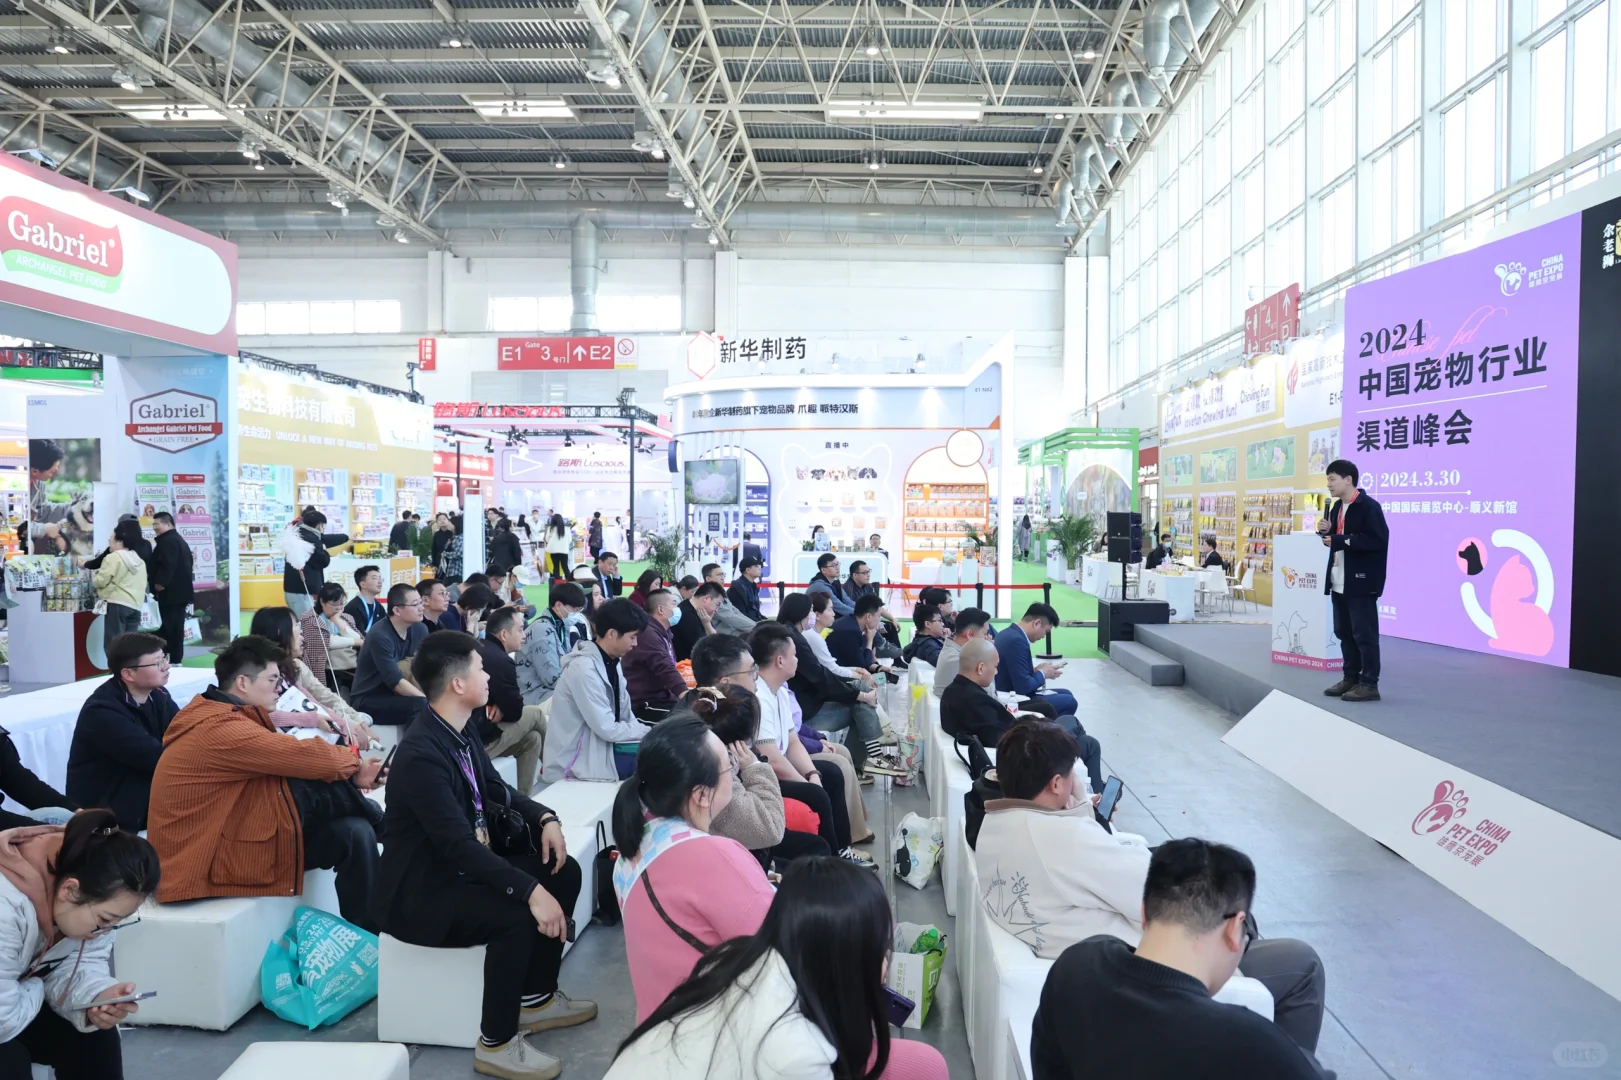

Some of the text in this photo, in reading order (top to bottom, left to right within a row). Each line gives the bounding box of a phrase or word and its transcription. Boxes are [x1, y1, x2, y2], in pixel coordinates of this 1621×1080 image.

[8, 210, 108, 267] Gabriel
[1541, 253, 1563, 268] CHINA
[16, 255, 107, 288] ARCHANGEL PET FOOD
[1528, 262, 1564, 281] PET EXPO
[1265, 306, 1271, 327] 4
[1282, 324, 1290, 341] P
[1360, 319, 1426, 358] 2024
[502, 346, 522, 361] E1
[525, 341, 540, 350] Gate
[541, 346, 551, 361] 3
[590, 345, 612, 361] E2
[720, 337, 807, 363] 新华制药
[1301, 354, 1343, 376] 国家高新技术
[1359, 336, 1547, 400] 中国宠物行业
[138, 404, 205, 419] Gabriel
[798, 404, 817, 414] 爪趣
[137, 425, 165, 434] Archangel
[166, 425, 187, 433] Gabriel
[198, 424, 212, 432] Food
[1357, 409, 1473, 452] 渠道峰会
[276, 430, 300, 443] UNLOCK
[309, 435, 321, 445] NEW
[324, 437, 336, 447] WAY
[337, 440, 344, 448] OF
[825, 441, 849, 449] 直播中
[557, 458, 582, 467] 路斯
[1380, 470, 1460, 487] 2024.3.30
[141, 487, 165, 495] Gabriel
[178, 488, 202, 496] Gabriel
[1382, 501, 1518, 514] 中国国际展览中心-顺义新馆
[182, 529, 208, 537] Gabriel
[1274, 654, 1323, 668] CHINA PET EXPO 2024
[1327, 661, 1344, 669] CHINA
[1446, 823, 1499, 856] PET EXPO
[1475, 819, 1511, 844] CHINA
